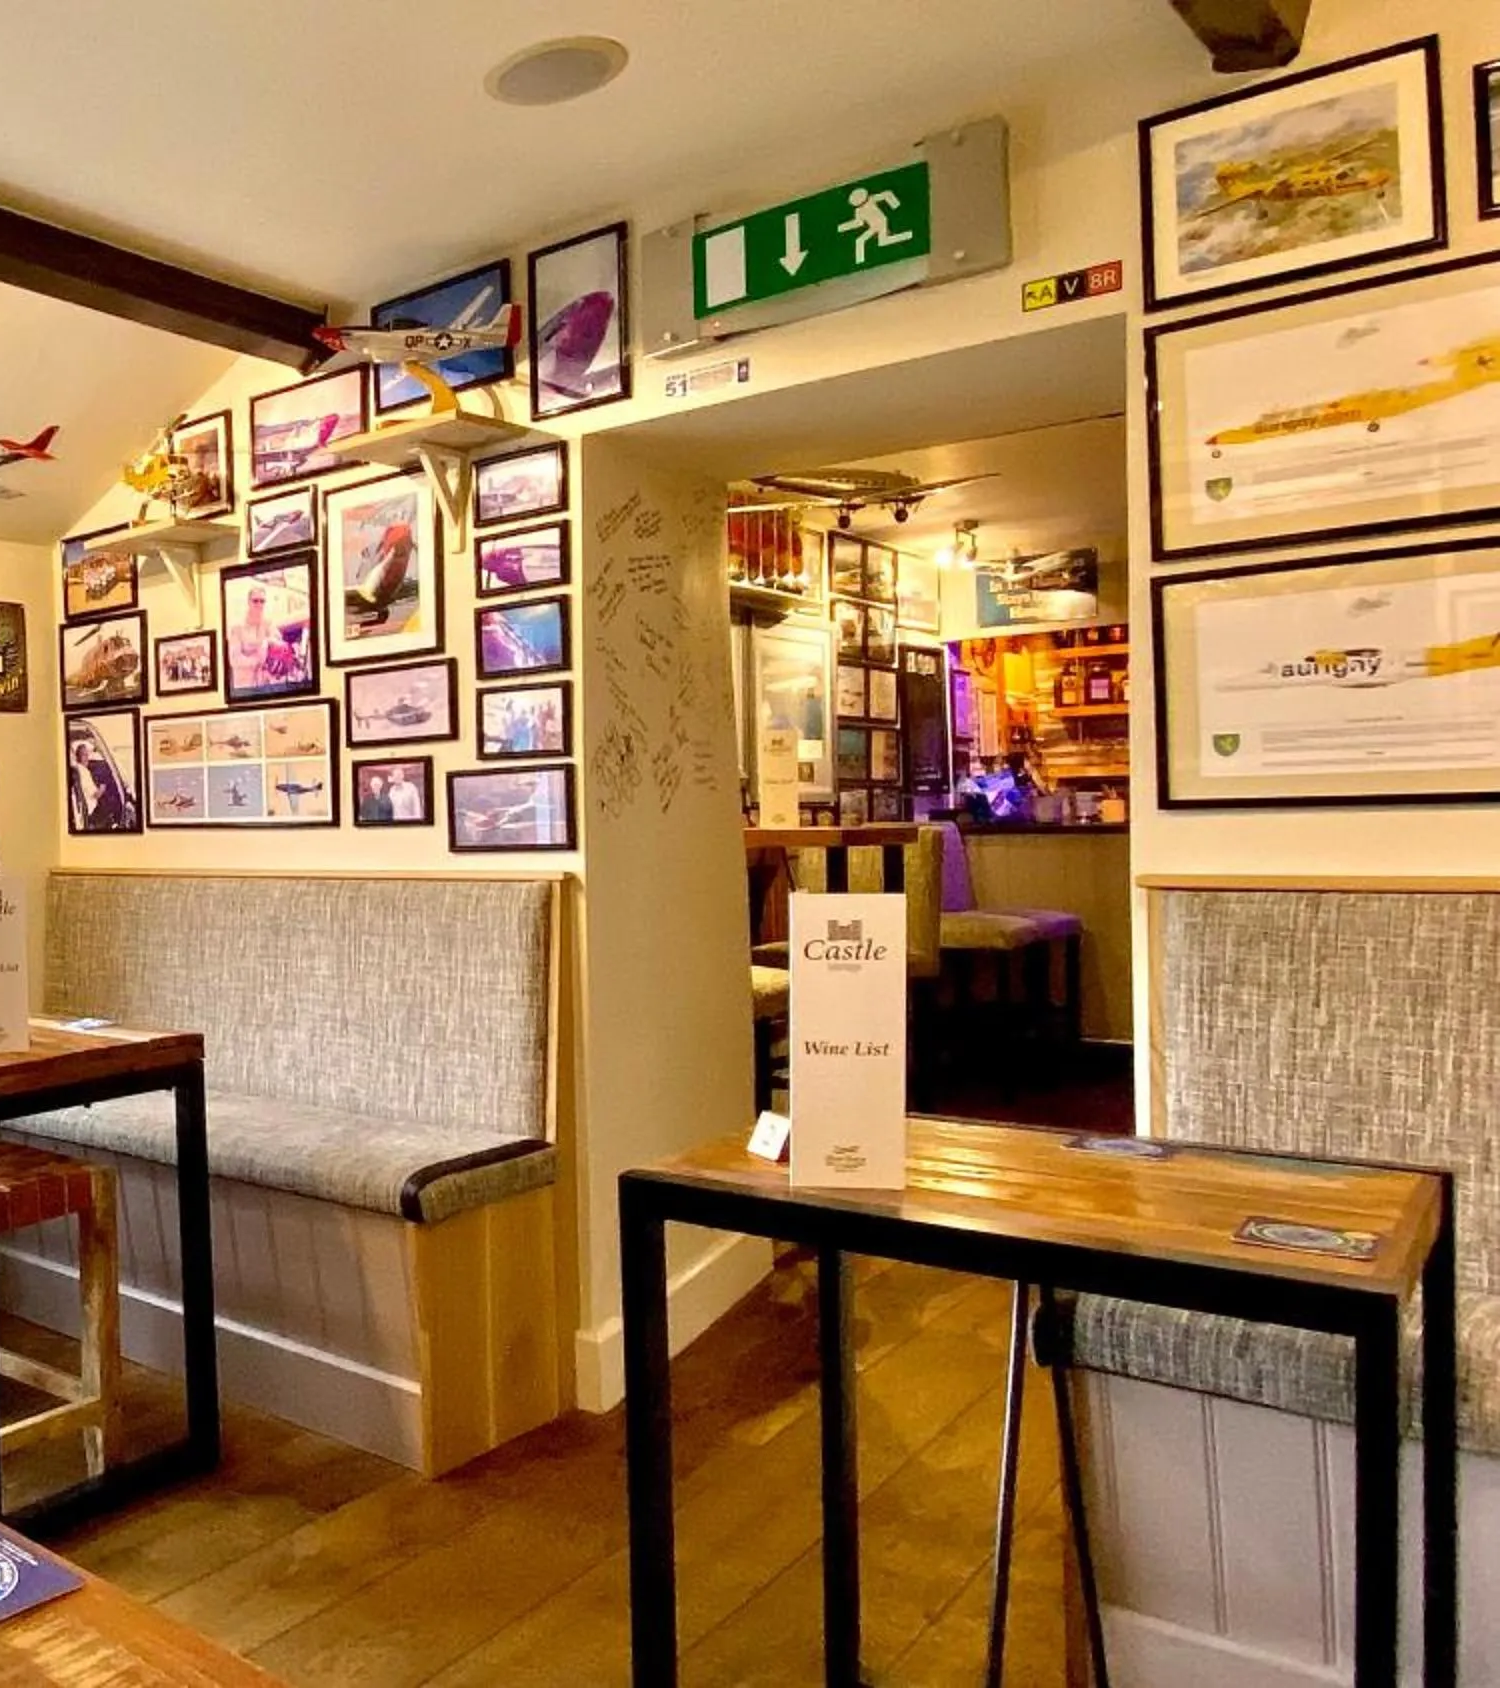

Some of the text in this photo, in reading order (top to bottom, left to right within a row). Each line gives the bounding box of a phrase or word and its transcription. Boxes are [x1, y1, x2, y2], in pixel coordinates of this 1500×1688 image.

[1063, 276, 1079, 296] V
[803, 937, 888, 961] Castle
[804, 1040, 891, 1057] Wine List
